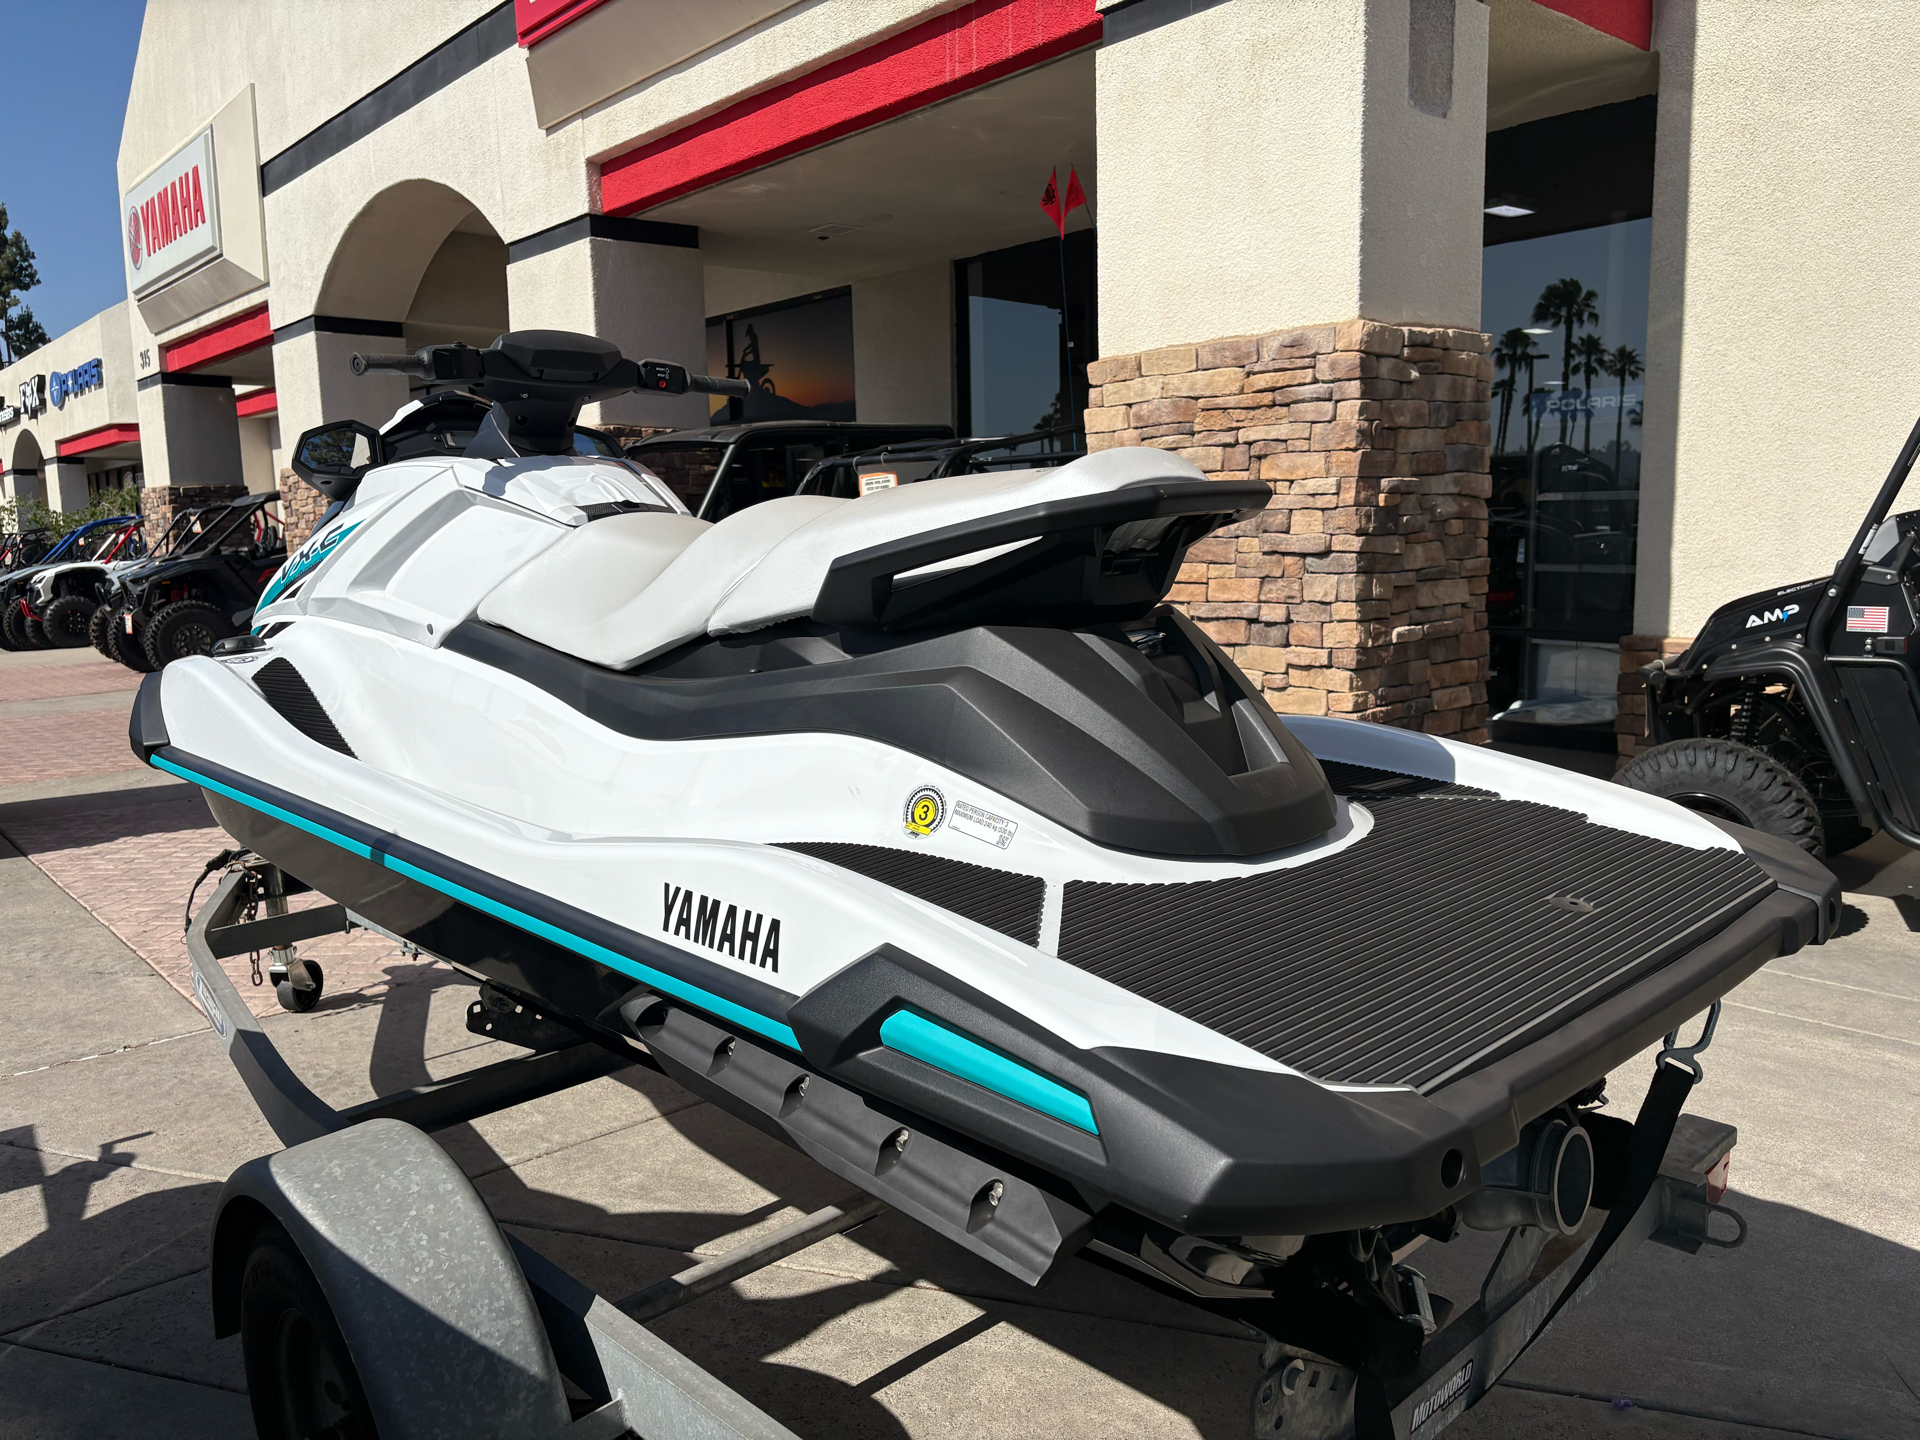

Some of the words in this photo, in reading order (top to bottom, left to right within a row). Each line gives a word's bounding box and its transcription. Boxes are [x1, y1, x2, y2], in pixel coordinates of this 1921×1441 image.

[140, 164, 206, 257] YAMAHA
[140, 348, 150, 370] 315
[61, 358, 99, 398] POLARIS
[20, 375, 39, 417] FOX
[1546, 394, 1637, 412] POLARIS
[1777, 583, 1815, 596] ELECTRIC
[1746, 604, 1800, 629] AMP
[919, 804, 930, 821] 3
[954, 809, 973, 821] MAXIMUM
[956, 802, 969, 812] RATED
[969, 807, 985, 818] PERSON
[662, 882, 781, 974] YAMAHA
